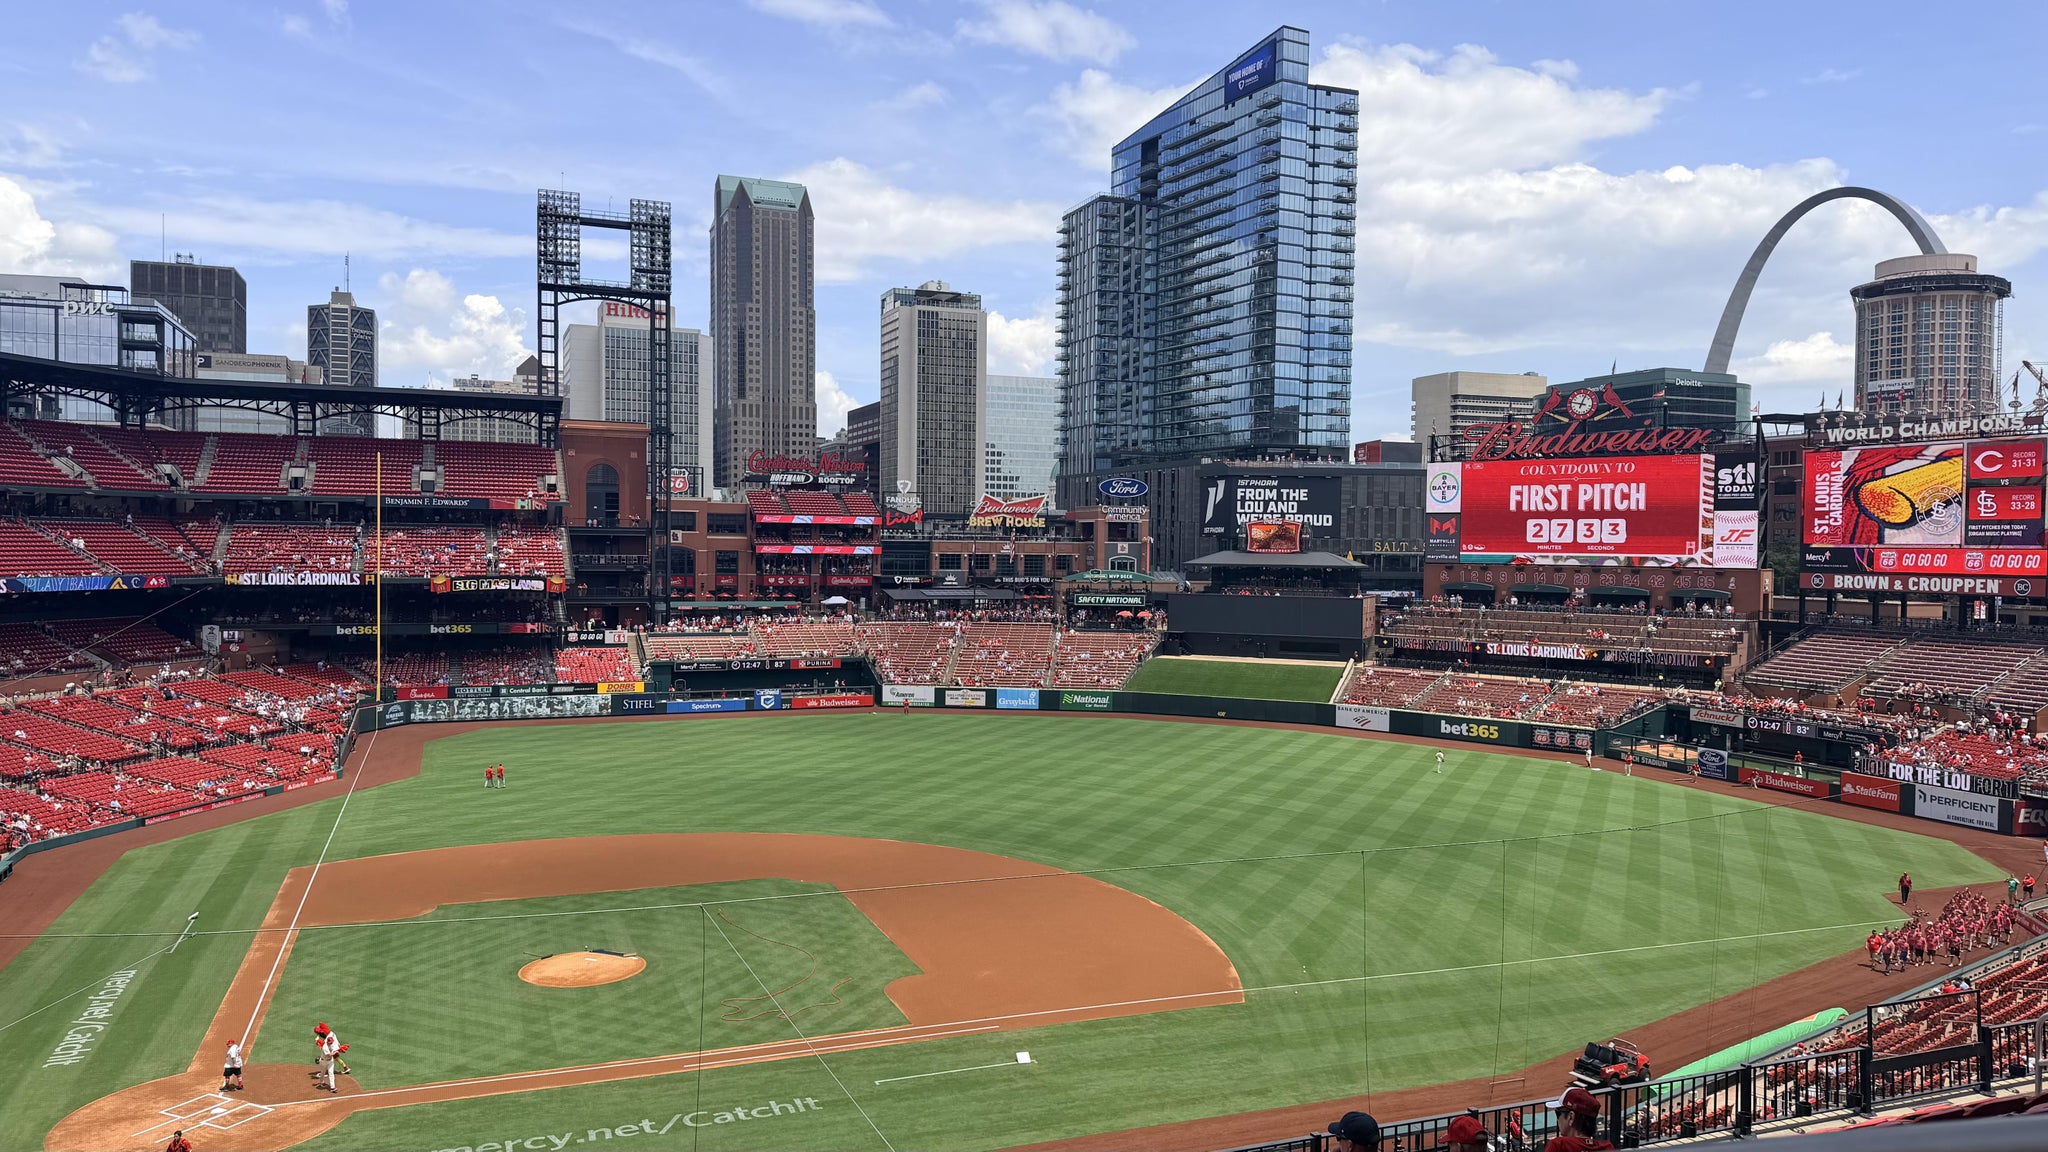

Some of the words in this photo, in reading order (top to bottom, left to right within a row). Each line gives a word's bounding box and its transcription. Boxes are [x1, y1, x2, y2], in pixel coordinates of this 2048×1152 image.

[63, 300, 115, 319] pwc
[1827, 426, 1893, 442] WORLD
[1899, 416, 2025, 438] CHAMPIONS
[1463, 419, 1712, 461] Budweiser
[748, 450, 812, 474] Cardinals
[812, 453, 865, 475] Nation
[1520, 462, 1612, 476] COUNTDOWN
[1616, 462, 1635, 473] TO
[2011, 459, 2036, 468] 31-31
[1109, 480, 1139, 494] Ford
[1814, 473, 1830, 512] LOUIS
[1829, 461, 1843, 526] CARDINALS
[1237, 488, 1277, 500] FROM
[1280, 489, 1308, 501] THE
[1509, 484, 1572, 512] FIRST
[1577, 482, 1647, 511] PITCH
[386, 497, 423, 505] BENJAMIN
[433, 498, 467, 506] EDWARDS
[1236, 501, 1263, 513] LOU
[1266, 501, 1298, 513] AND
[2010, 501, 2035, 510] 33-28
[1101, 505, 1147, 515] Community
[969, 516, 1004, 527] BREW
[1006, 517, 1046, 528] HOUSE
[1814, 515, 1830, 534] ST.
[1806, 553, 1826, 562] Mercy
[1902, 554, 1915, 566] GO
[1917, 554, 1931, 566] GO
[1933, 554, 1947, 567] GO
[1989, 555, 2004, 567] GO
[2006, 555, 2022, 568] GO
[2024, 555, 2040, 568] GO
[244, 573, 259, 585] ST.
[261, 573, 295, 585] LOUIS
[297, 573, 360, 585] CARDINALS
[452, 580, 478, 591] BIG
[479, 579, 510, 590] MAC
[511, 579, 544, 591] LAND
[1834, 575, 1889, 589] BROWN
[1893, 579, 1904, 590] &
[1908, 577, 1999, 594] CROUPPEN
[1078, 596, 1105, 604] SAFETY
[1105, 596, 1142, 604] NATIONAL
[336, 625, 379, 635] bet365
[430, 625, 472, 634] bet365
[1501, 644, 1529, 657] LOUIS
[1530, 645, 1586, 661] CARDINALS
[623, 698, 655, 709] STIFEL
[820, 698, 860, 707] Budweiser
[1073, 695, 1110, 703] National
[1694, 710, 1739, 721] Schnucks
[1441, 720, 1499, 739] bet365
[1760, 721, 1781, 731] 12:47
[1641, 756, 1668, 768] STADIUM
[1703, 752, 1720, 763] Ford
[1765, 774, 1814, 793] Budweiser
[1889, 763, 1913, 782] FOR
[1916, 766, 1941, 786] THE
[1944, 771, 1970, 791] LOU
[1930, 794, 1996, 814] PERFICIENT
[42, 969, 138, 1069] mercy.net/CatchIt
